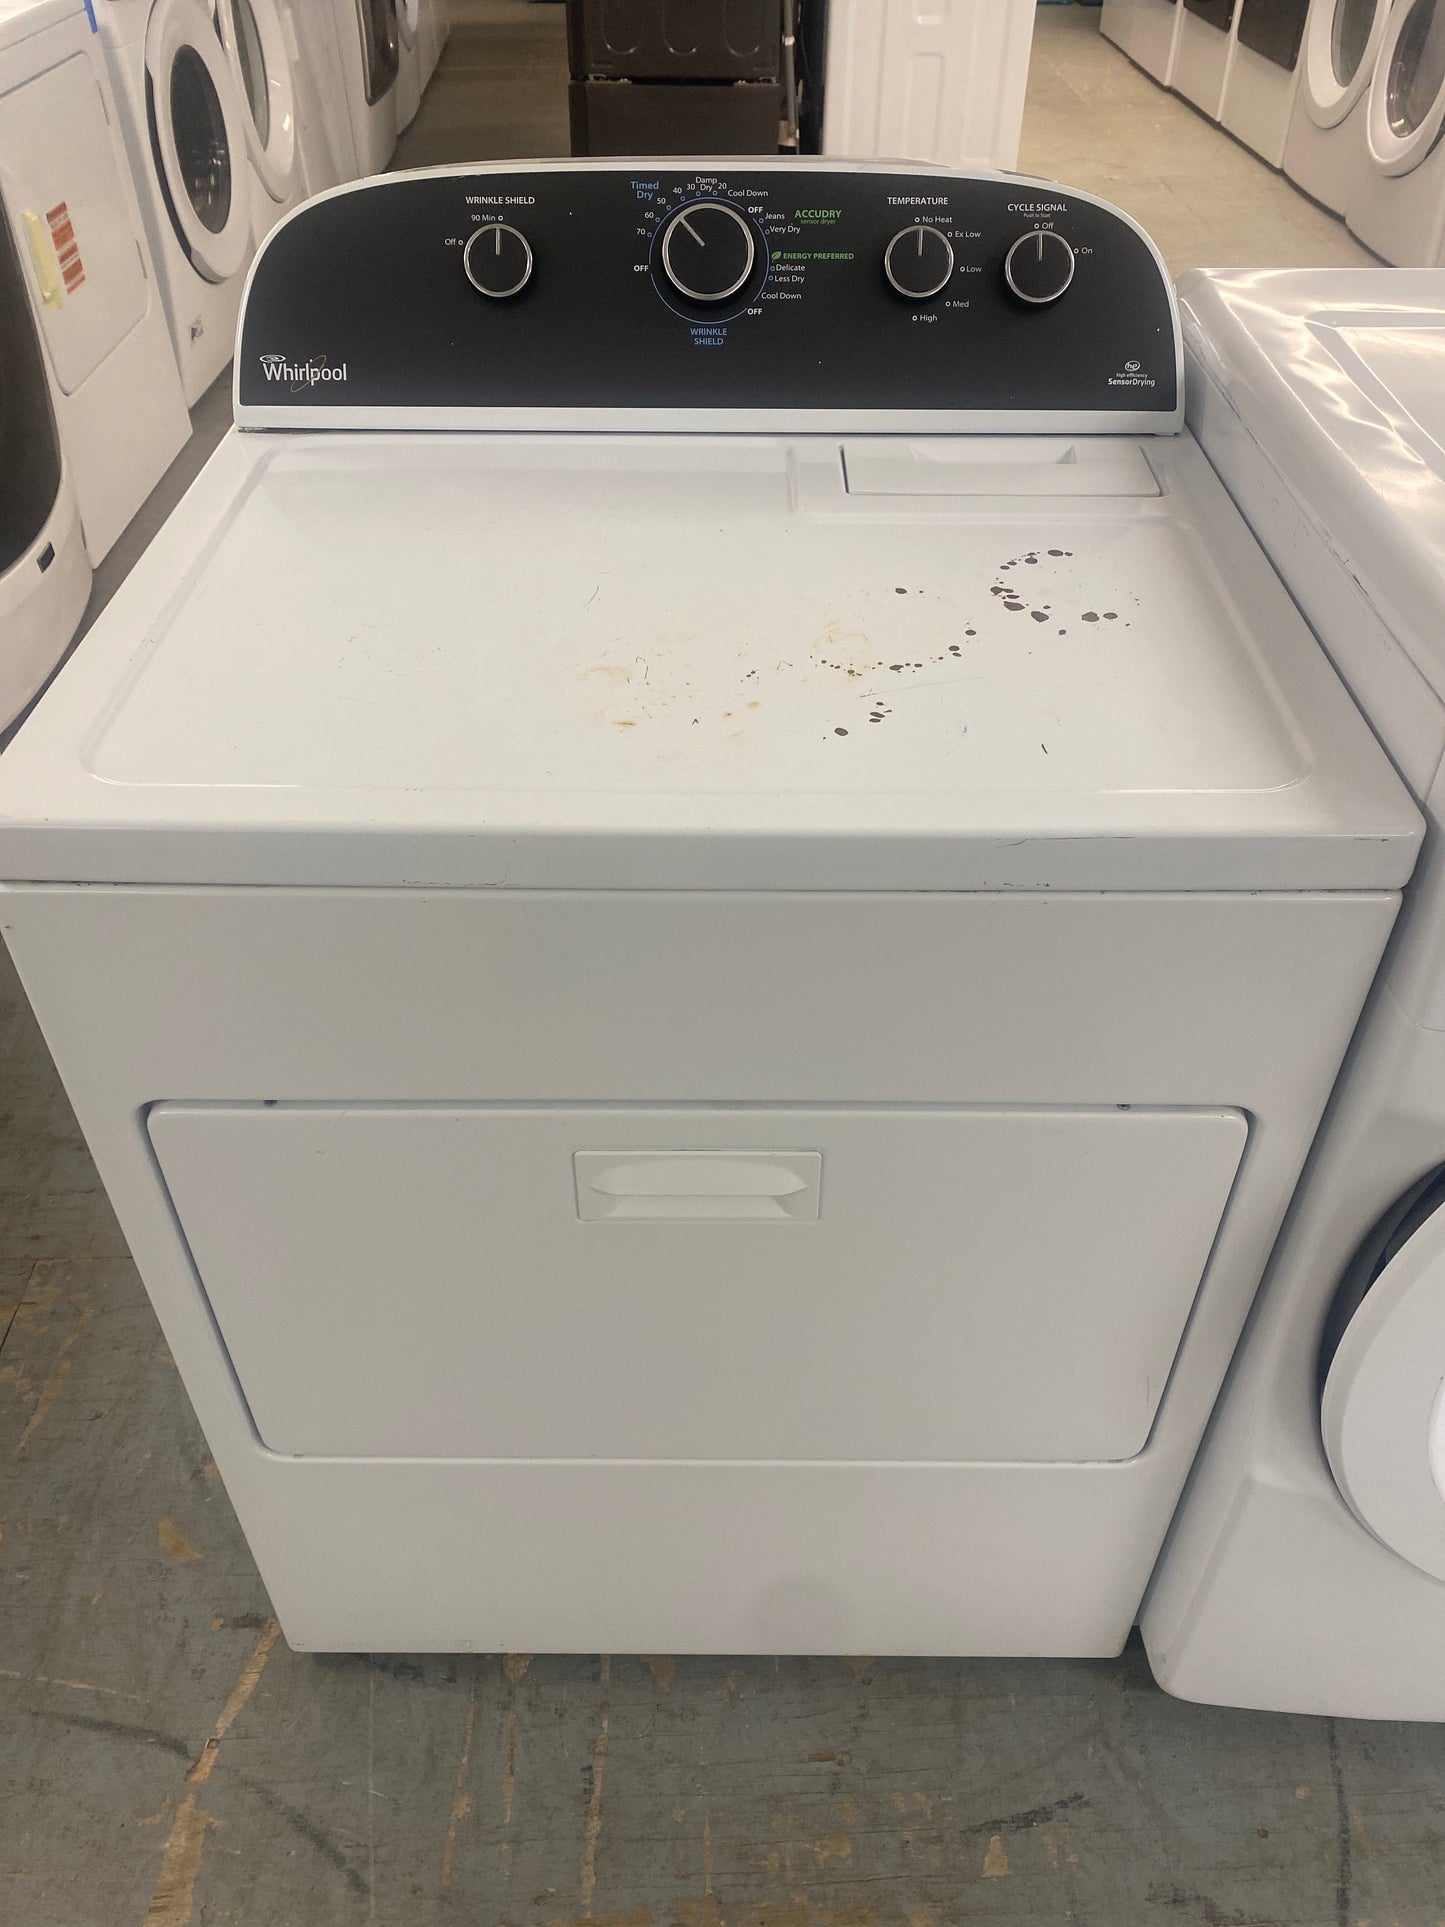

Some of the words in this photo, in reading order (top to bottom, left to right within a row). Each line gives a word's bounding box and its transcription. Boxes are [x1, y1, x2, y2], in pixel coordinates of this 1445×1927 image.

[695, 177, 717, 185] Damp
[630, 181, 660, 190] Timed
[700, 183, 713, 192] Dry
[636, 190, 653, 200] Dry
[728, 189, 745, 197] Cool
[746, 189, 769, 197] Down
[465, 196, 503, 205] WRINKLE
[505, 196, 535, 205] SHIELD
[887, 197, 948, 205] TEMPERATURE
[748, 206, 764, 214] OFF
[1007, 204, 1034, 212] CYCLE
[1036, 204, 1068, 212] SIGNAL
[644, 211, 654, 219] 60
[794, 209, 842, 218] ACCUDRY
[471, 214, 480, 222] 90
[481, 214, 496, 222] Min
[770, 225, 786, 234] Very
[787, 225, 801, 234] Dry
[1041, 222, 1054, 230] Off
[444, 238, 457, 246] Off
[633, 265, 649, 273] OFF
[776, 264, 806, 272] Delicate
[774, 275, 790, 283] Less
[791, 275, 805, 284] Dry
[761, 292, 778, 300] Cool
[779, 292, 801, 300] Down
[952, 300, 970, 308] Med
[747, 307, 763, 316] OFF
[919, 314, 938, 323] High
[690, 328, 728, 336] WRINKLE
[694, 337, 724, 346] SHIELD
[262, 358, 347, 386] Whirlpool
[1108, 378, 1156, 387] SensorDrying
